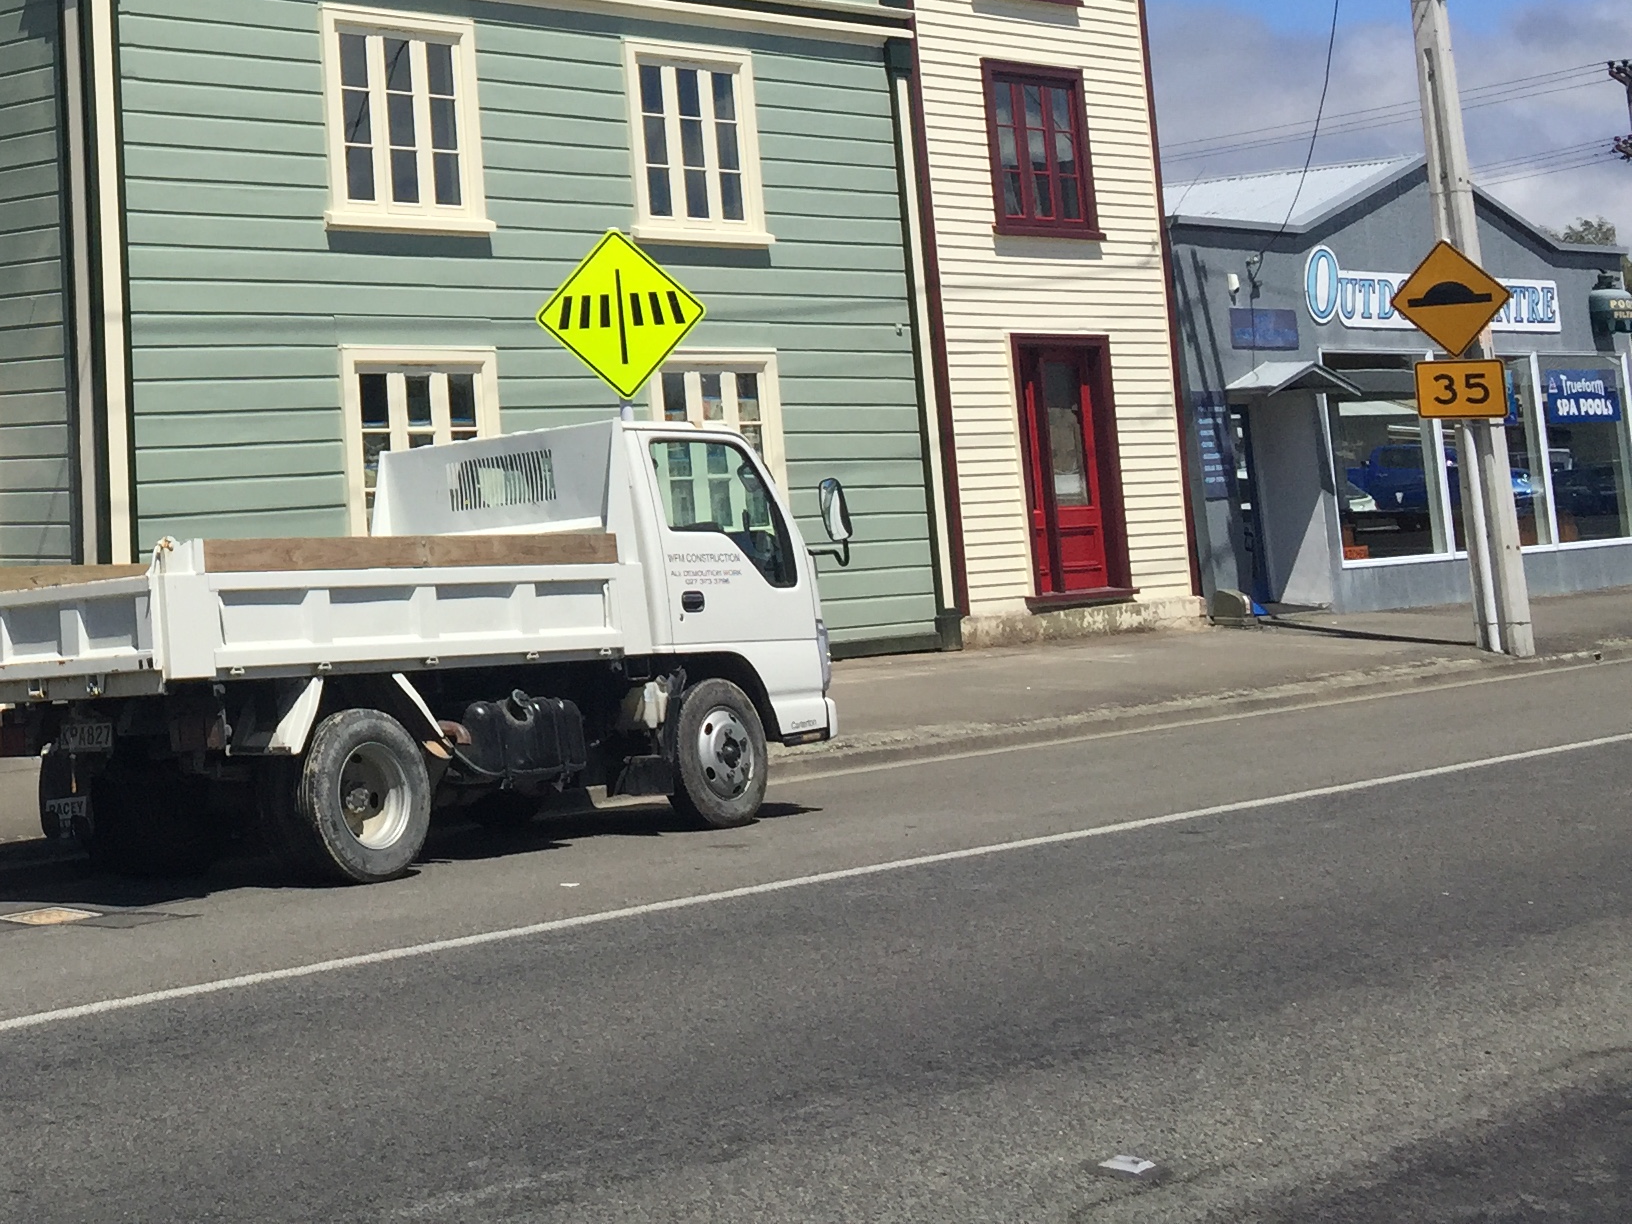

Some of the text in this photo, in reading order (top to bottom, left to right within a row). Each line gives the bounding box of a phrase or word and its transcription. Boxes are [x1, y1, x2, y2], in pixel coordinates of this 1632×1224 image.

[1307, 250, 1407, 320] OUTD
[1433, 373, 1490, 405] 35
[1560, 374, 1605, 396] Trueform
[1556, 398, 1613, 416] SPA POOLS
[686, 553, 741, 563] CONSTRUCTION
